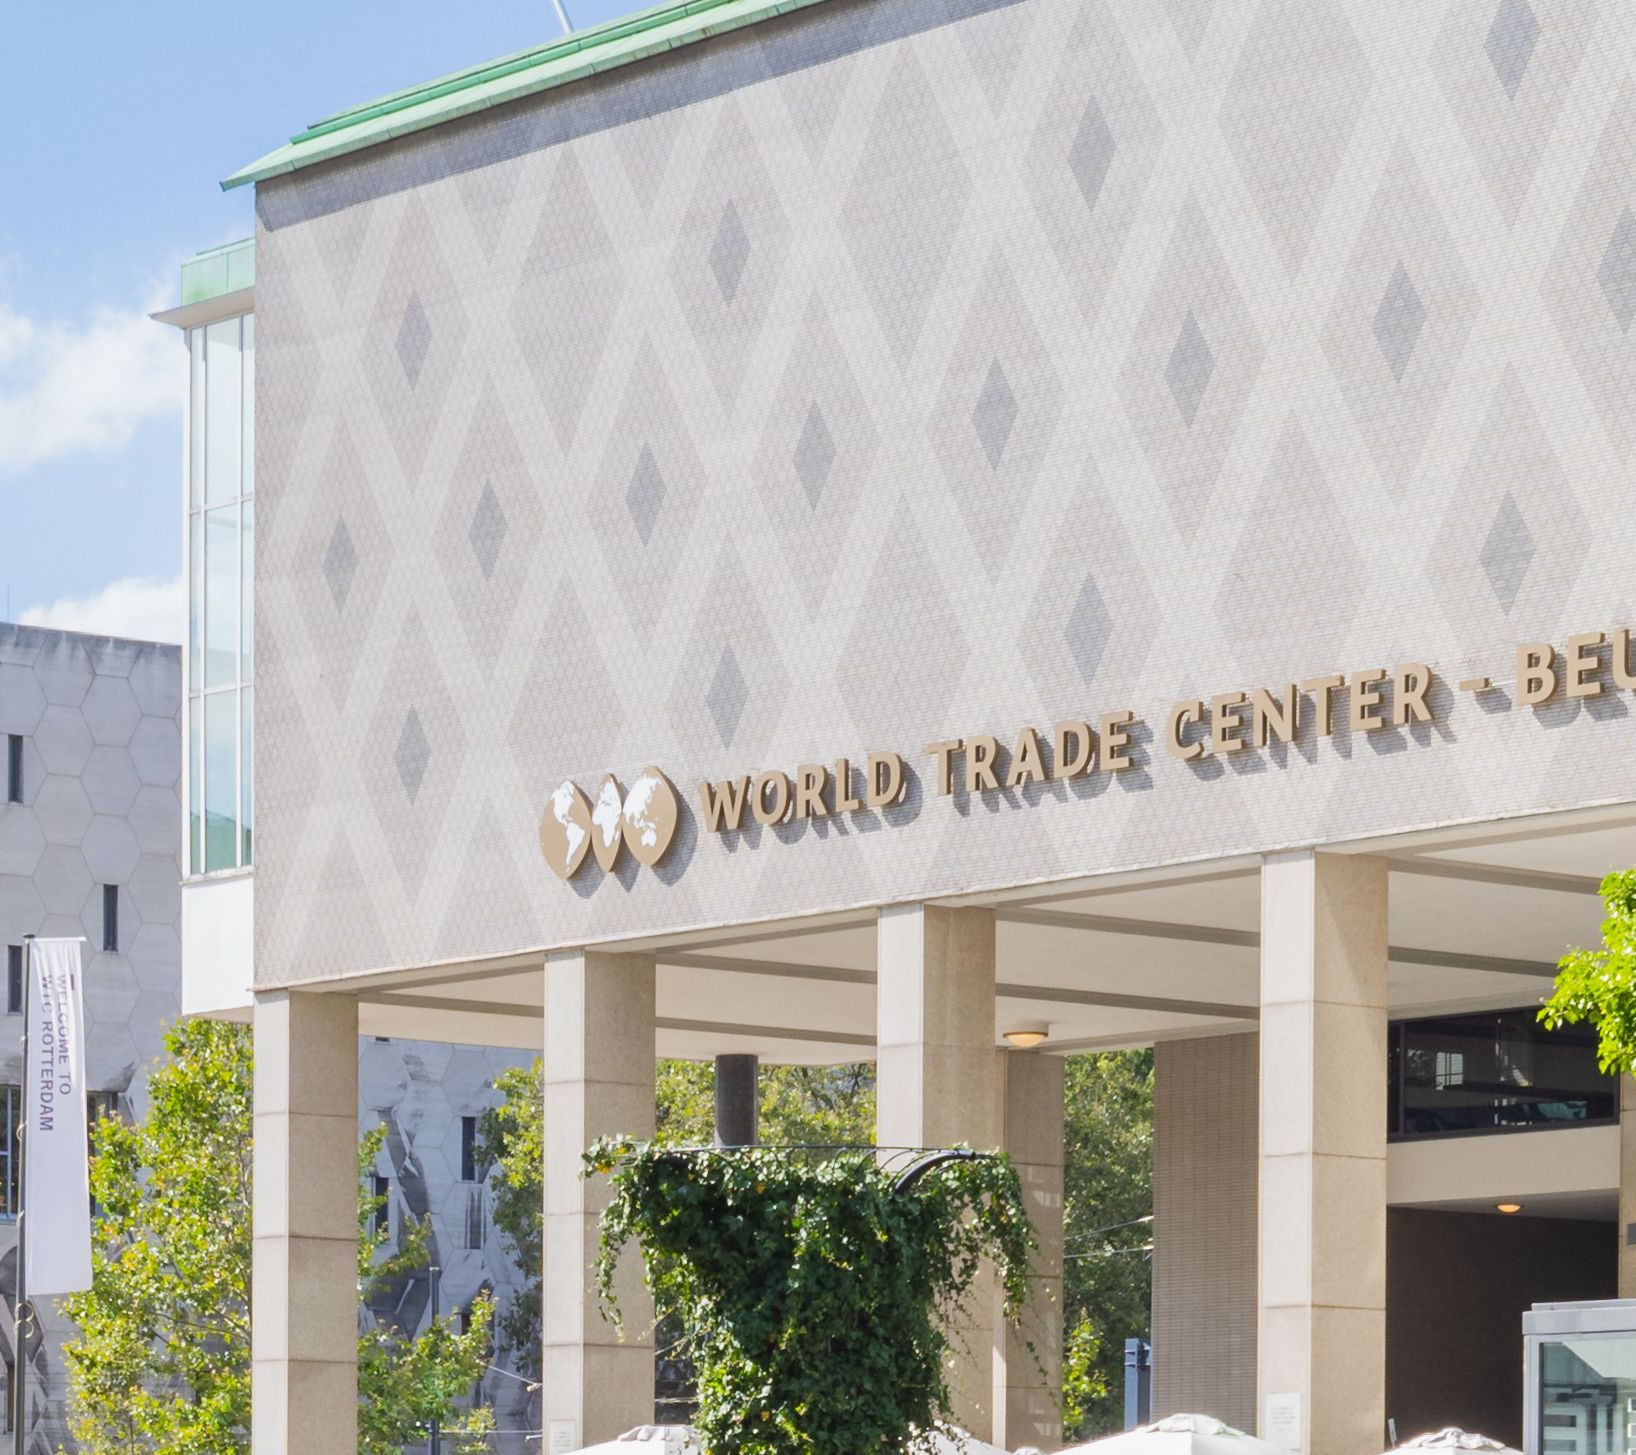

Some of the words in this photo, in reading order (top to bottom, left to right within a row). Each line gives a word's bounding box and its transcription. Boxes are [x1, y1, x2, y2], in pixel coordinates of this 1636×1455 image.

[698, 750, 906, 834] WORLD
[927, 709, 1136, 802] TRADE
[1164, 663, 1436, 762] CENTER
[40, 975, 53, 1016] WTC
[56, 974, 70, 1064] WELCOME
[39, 1021, 55, 1132] ROTTERDAM
[58, 1072, 72, 1096] TO
